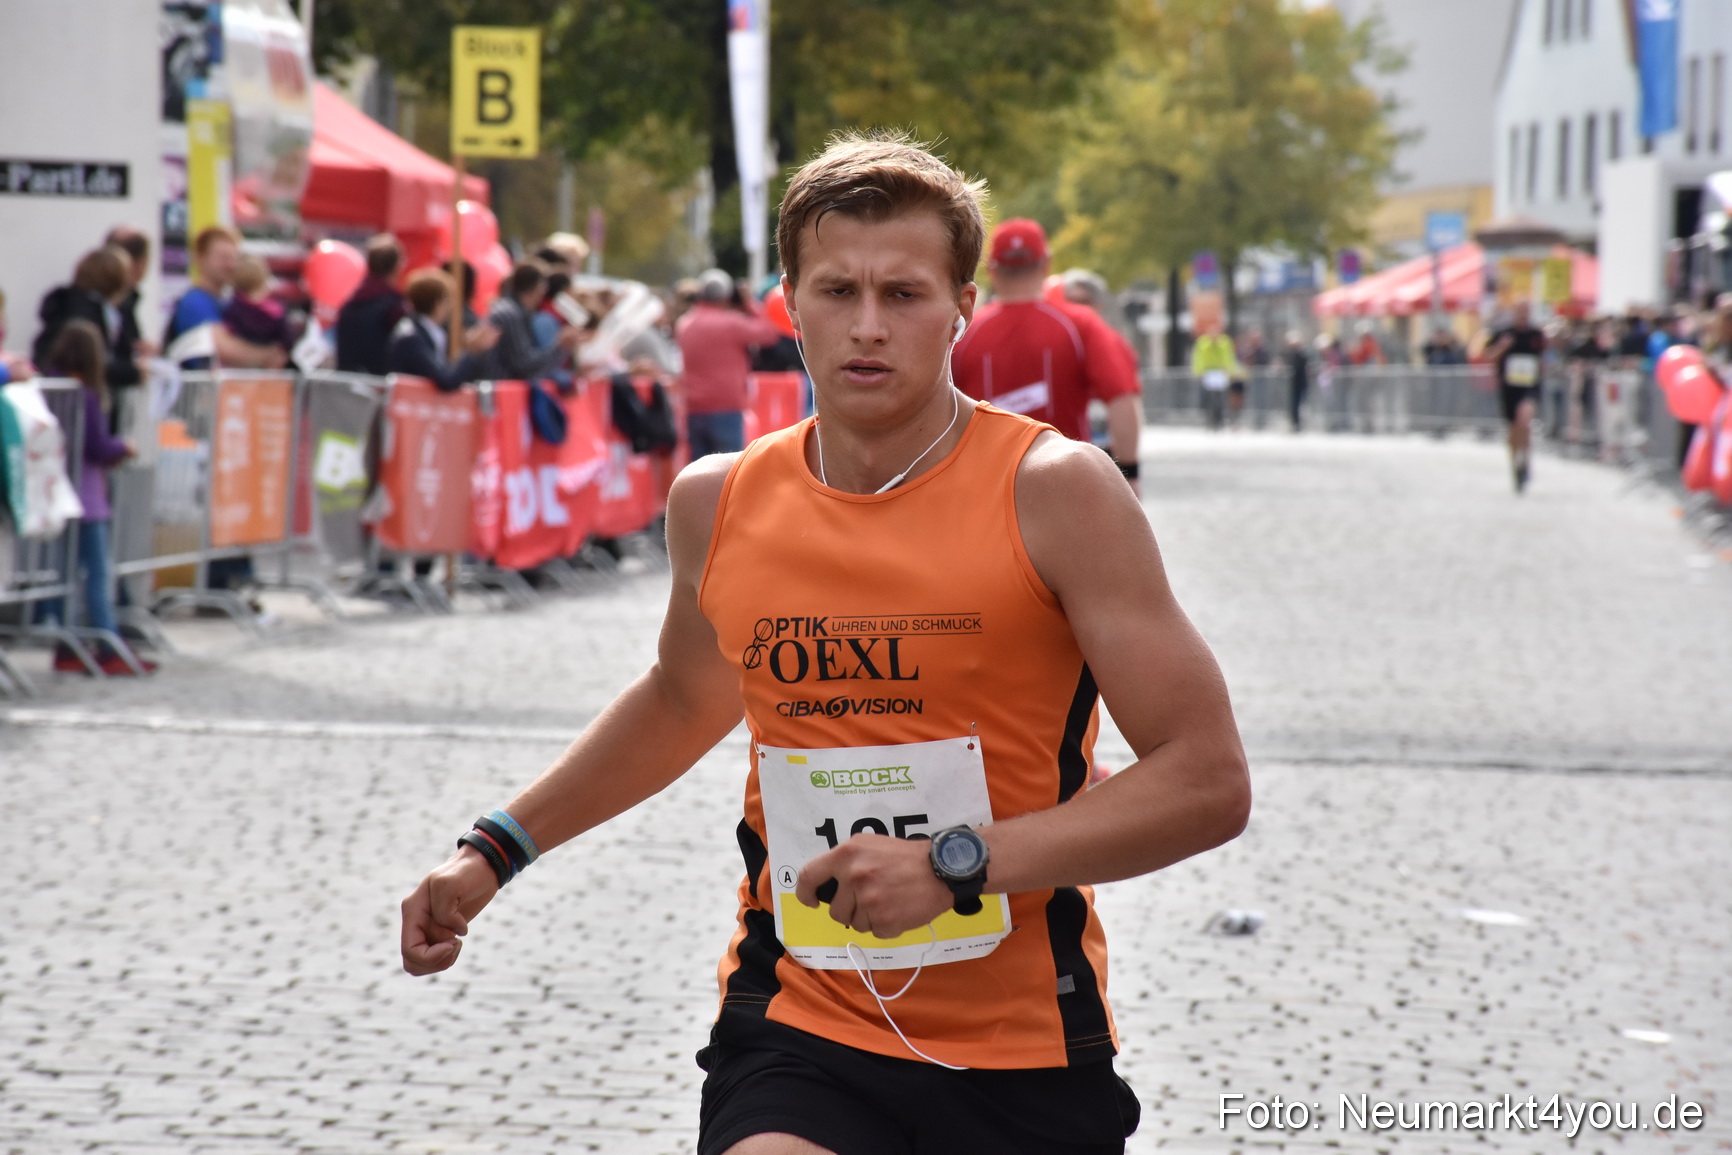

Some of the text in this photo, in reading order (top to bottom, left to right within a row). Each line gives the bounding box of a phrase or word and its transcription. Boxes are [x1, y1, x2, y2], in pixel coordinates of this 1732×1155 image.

[478, 69, 514, 125] B
[832, 617, 982, 633] UHREN UND SCHMUCK
[769, 637, 919, 684] OEXL
[776, 698, 923, 718] CIBA VISION
[831, 766, 914, 788] BOCK
[833, 788, 858, 796] inspired
[859, 787, 867, 795] by
[887, 784, 916, 792] concepts
[784, 871, 792, 884] A
